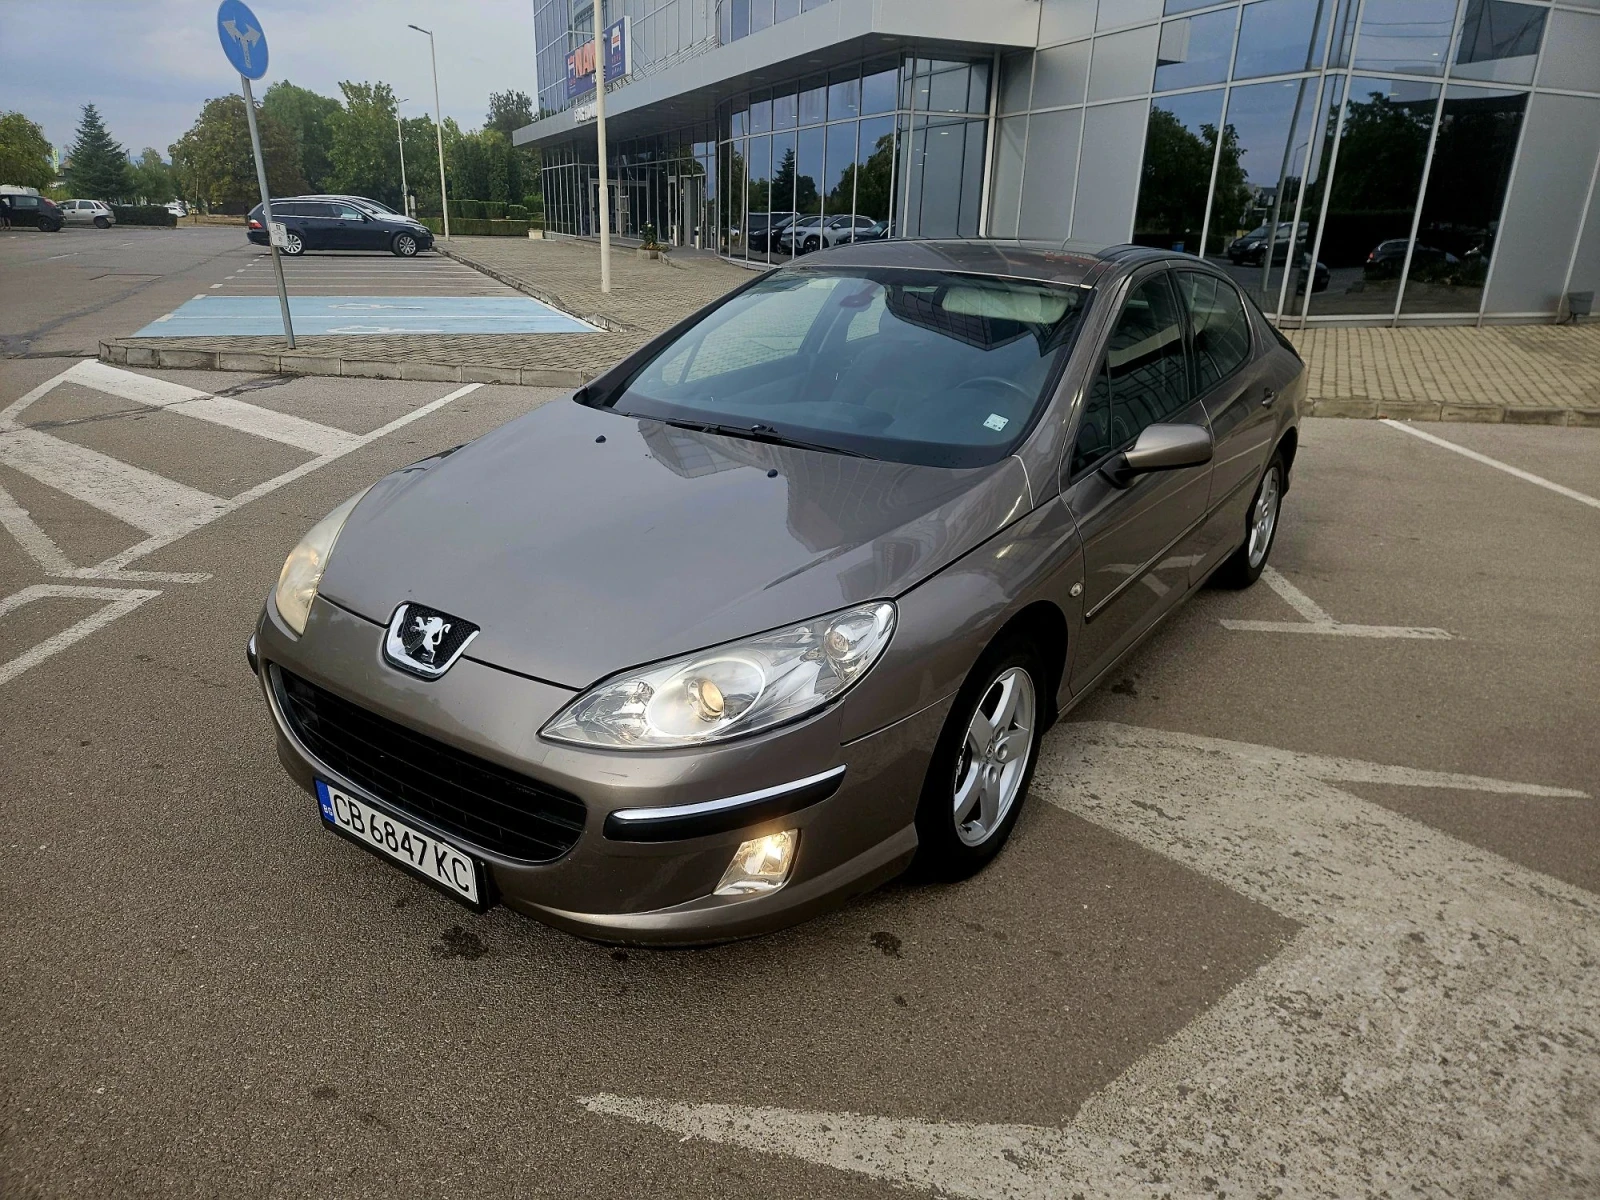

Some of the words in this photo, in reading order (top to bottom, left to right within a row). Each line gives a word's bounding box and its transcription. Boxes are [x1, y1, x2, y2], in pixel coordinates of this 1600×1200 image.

[323, 803, 334, 816] BG
[333, 794, 365, 834] CB
[369, 813, 428, 866] 6847
[434, 843, 470, 893] KC
